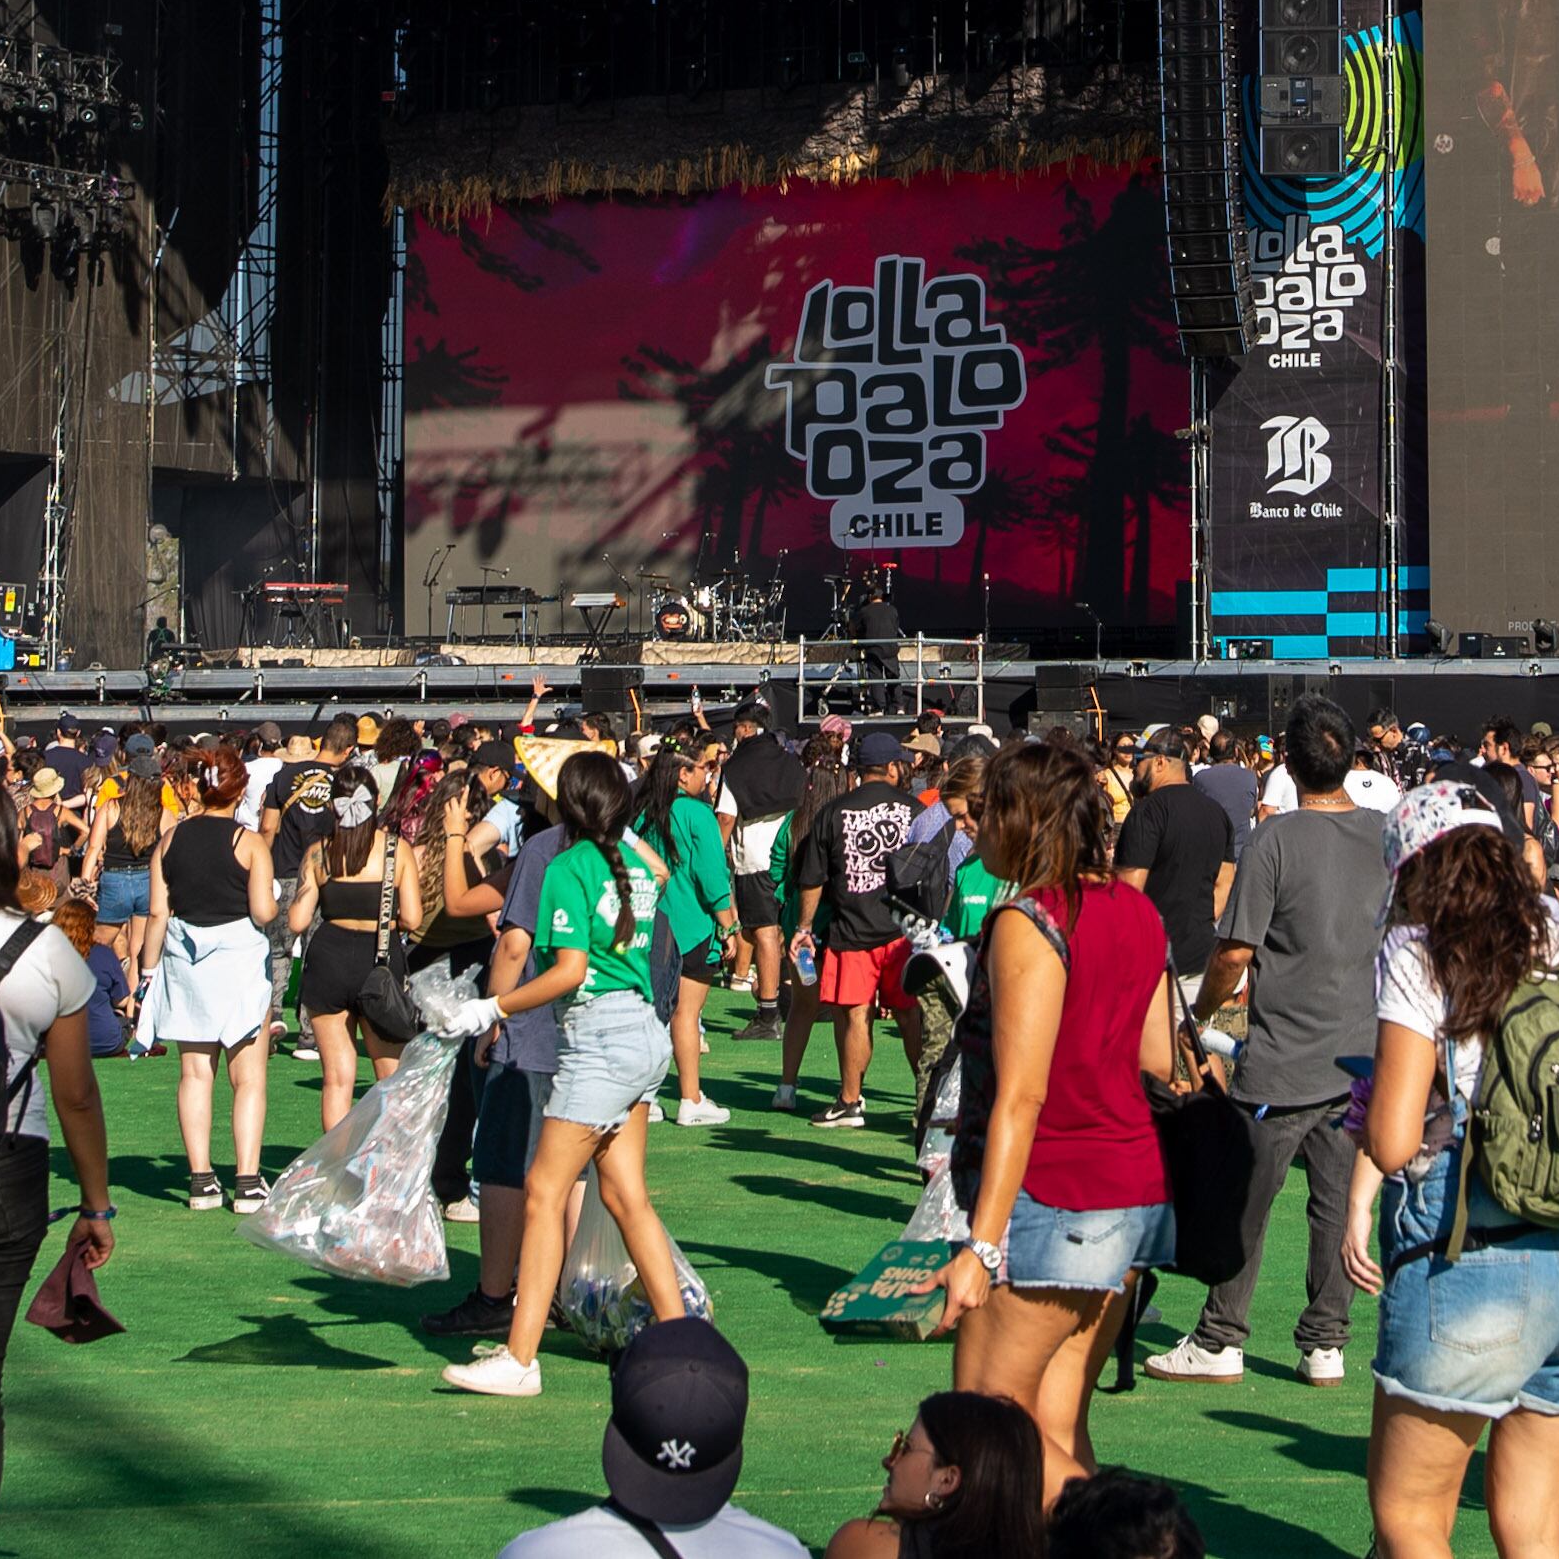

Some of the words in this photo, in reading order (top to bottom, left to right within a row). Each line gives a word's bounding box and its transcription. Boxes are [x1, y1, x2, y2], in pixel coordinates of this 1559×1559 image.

[1268, 353, 1322, 369] CHILE
[1249, 502, 1290, 518] Banco
[1293, 503, 1307, 518] de
[1310, 502, 1342, 519] Chile
[849, 512, 943, 538] CHILE
